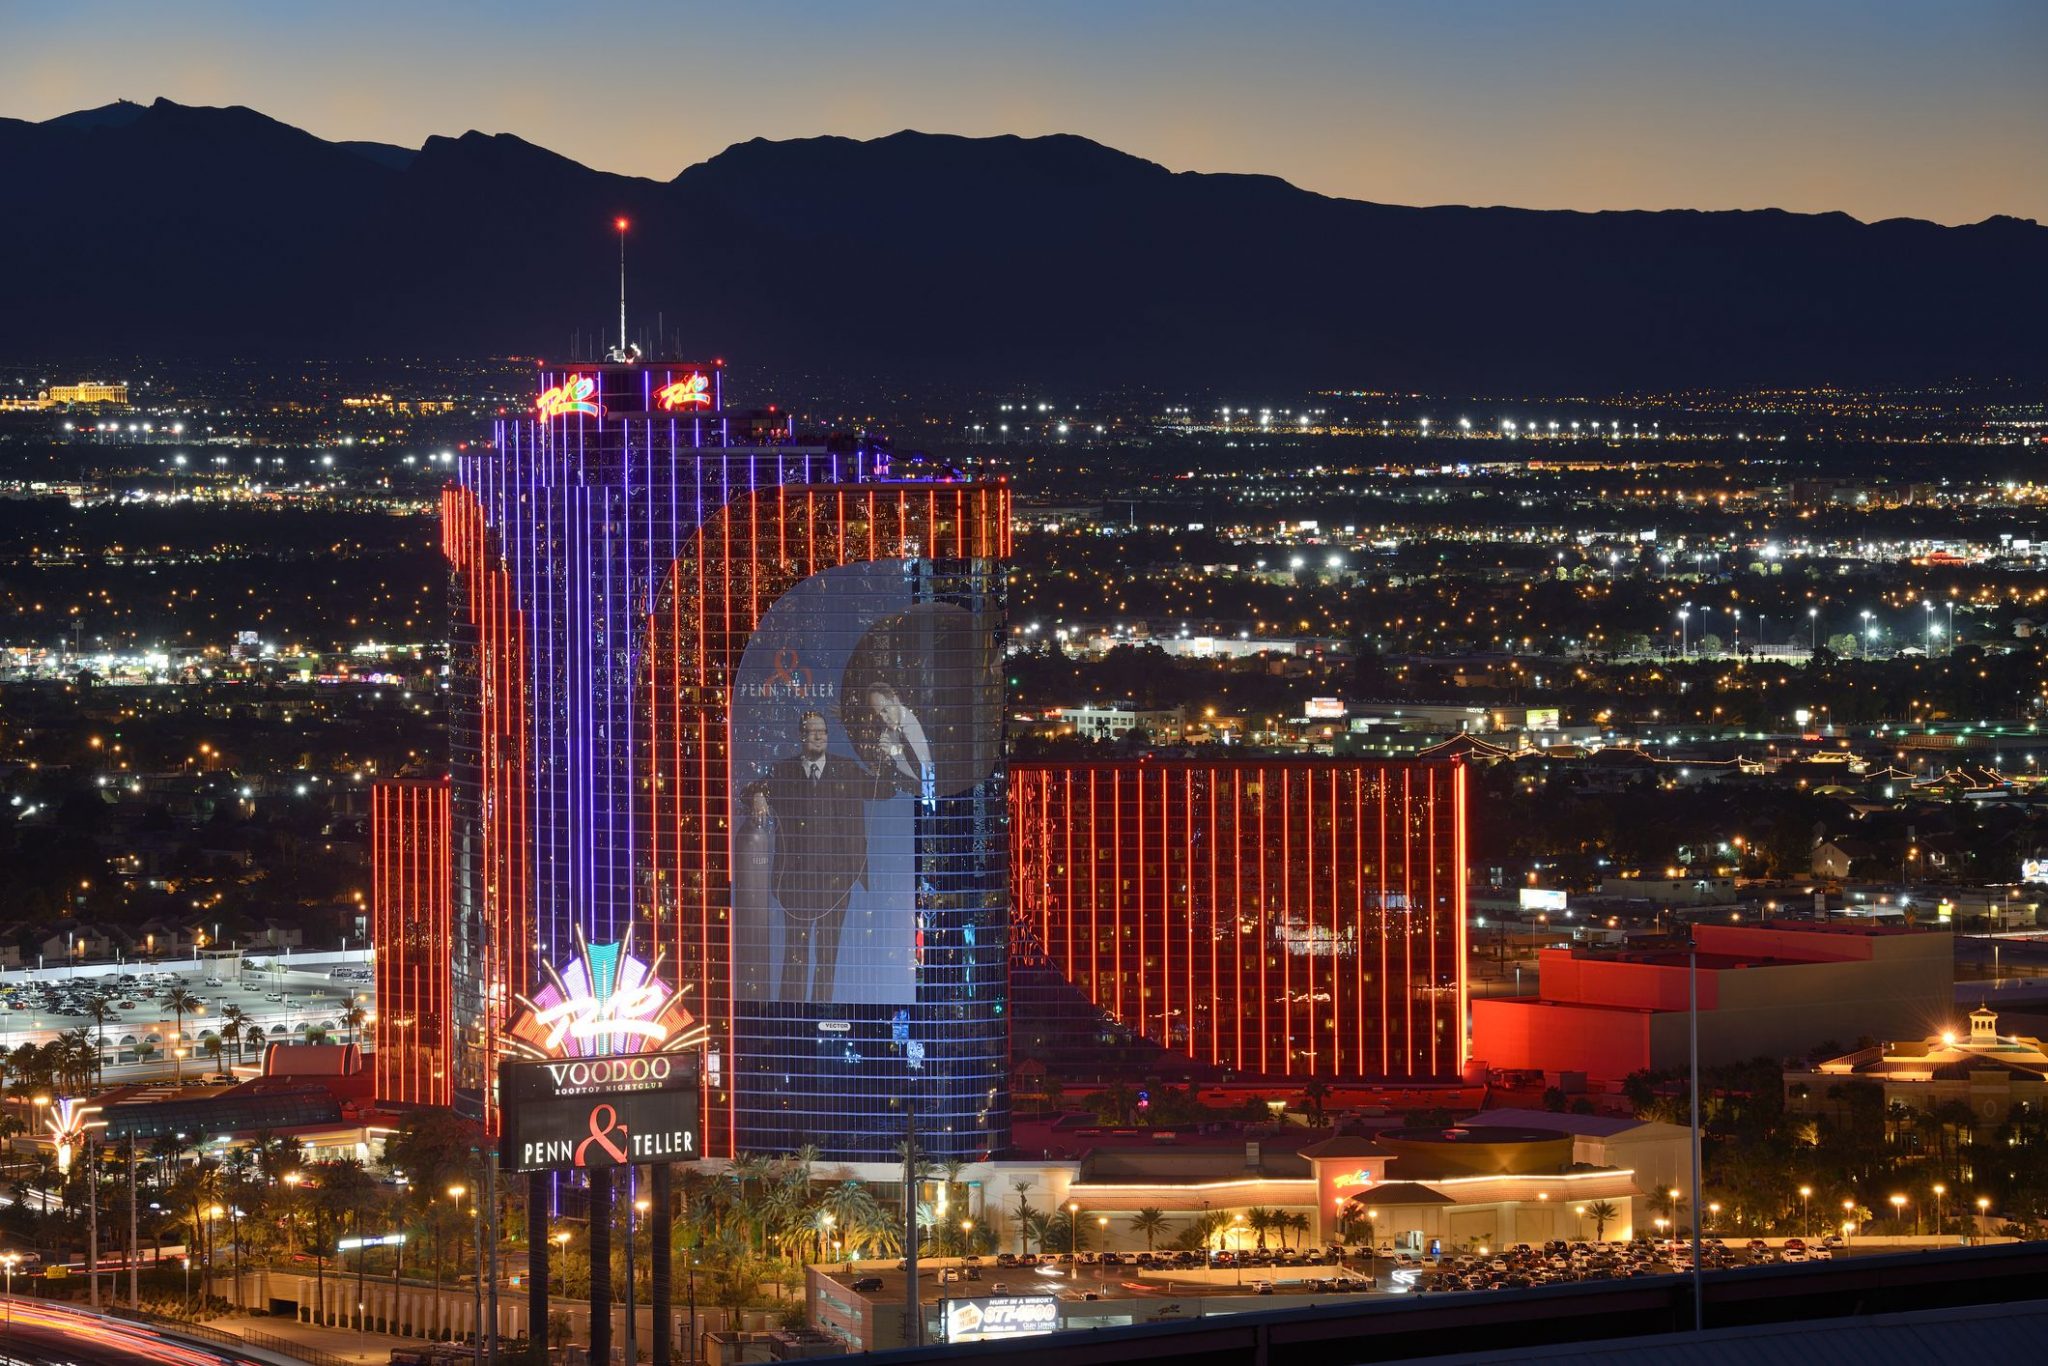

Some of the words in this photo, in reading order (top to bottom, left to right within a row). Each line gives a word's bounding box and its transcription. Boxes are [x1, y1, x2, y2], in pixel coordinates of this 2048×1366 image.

[536, 374, 597, 423] Rio
[660, 374, 711, 410] Rio
[740, 683, 777, 697] PENN
[785, 683, 834, 697] TELLER
[549, 1057, 670, 1086] VOODOO
[554, 1086, 600, 1096] ROOFTOP
[605, 1081, 664, 1093] NIGHTCLUB
[524, 1140, 573, 1164] PENN
[574, 1103, 628, 1167] &
[633, 1131, 693, 1156] TELLER
